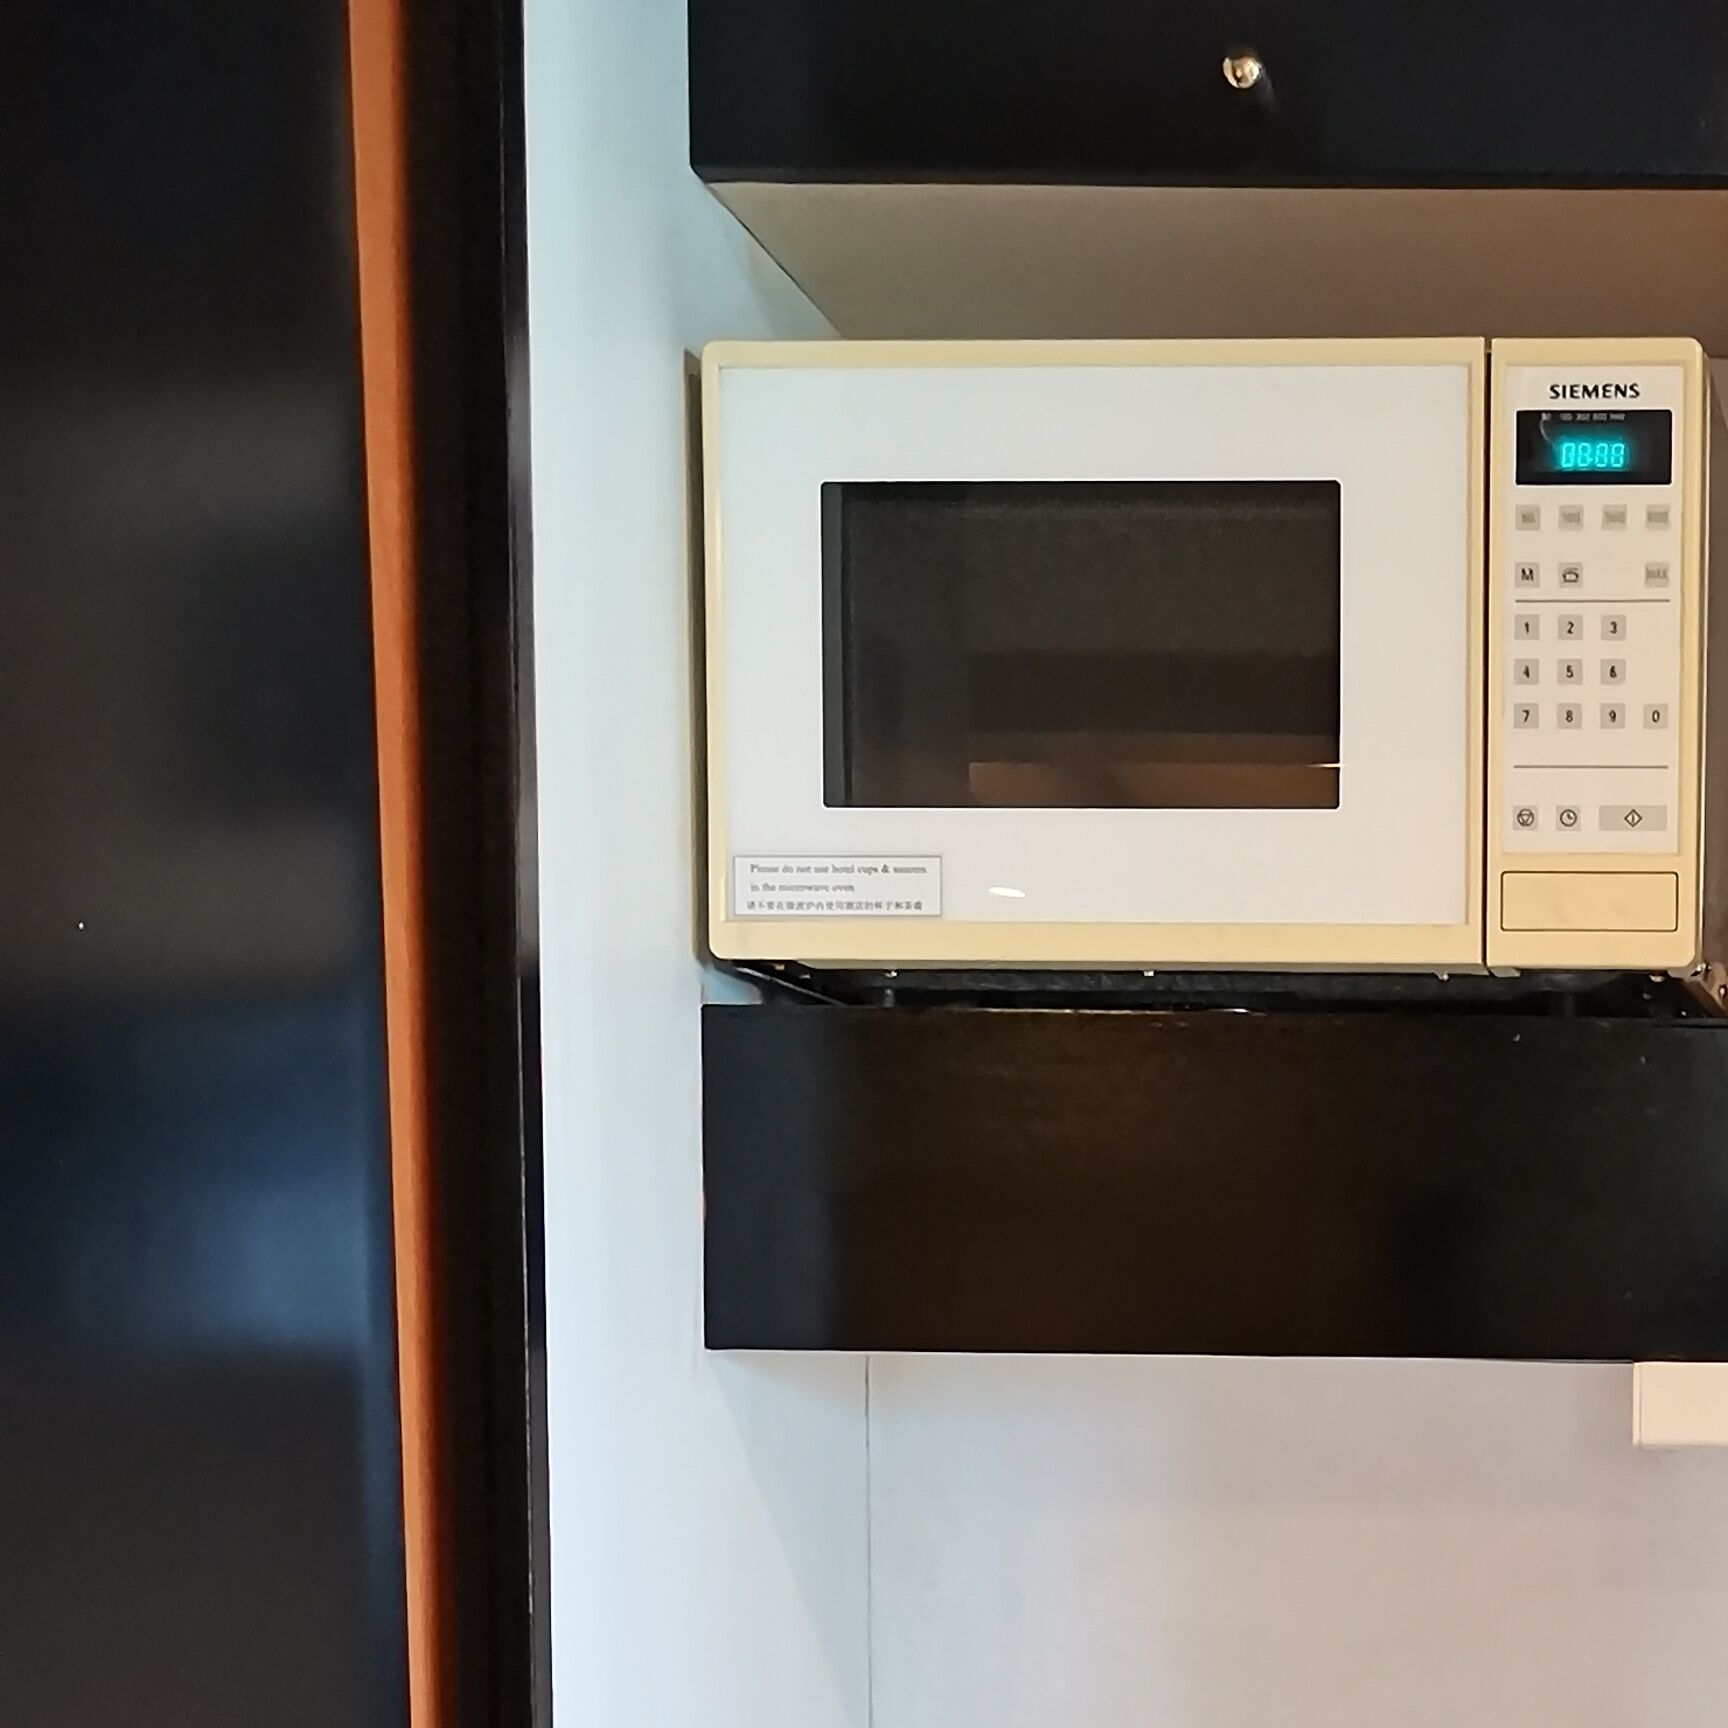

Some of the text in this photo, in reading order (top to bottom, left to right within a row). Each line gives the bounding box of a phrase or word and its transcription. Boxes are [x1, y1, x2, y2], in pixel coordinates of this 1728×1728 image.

[1549, 383, 1641, 400] SIEMENS
[1523, 621, 1618, 635] 1 2 3
[1522, 665, 1618, 679] 4 5 6
[1522, 709, 1660, 723] 7 8 9 0
[782, 864, 794, 874] do
[796, 865, 812, 874] not
[832, 864, 855, 874] hotel
[858, 866, 878, 876] cups
[881, 864, 890, 873] &
[762, 882, 777, 892] the
